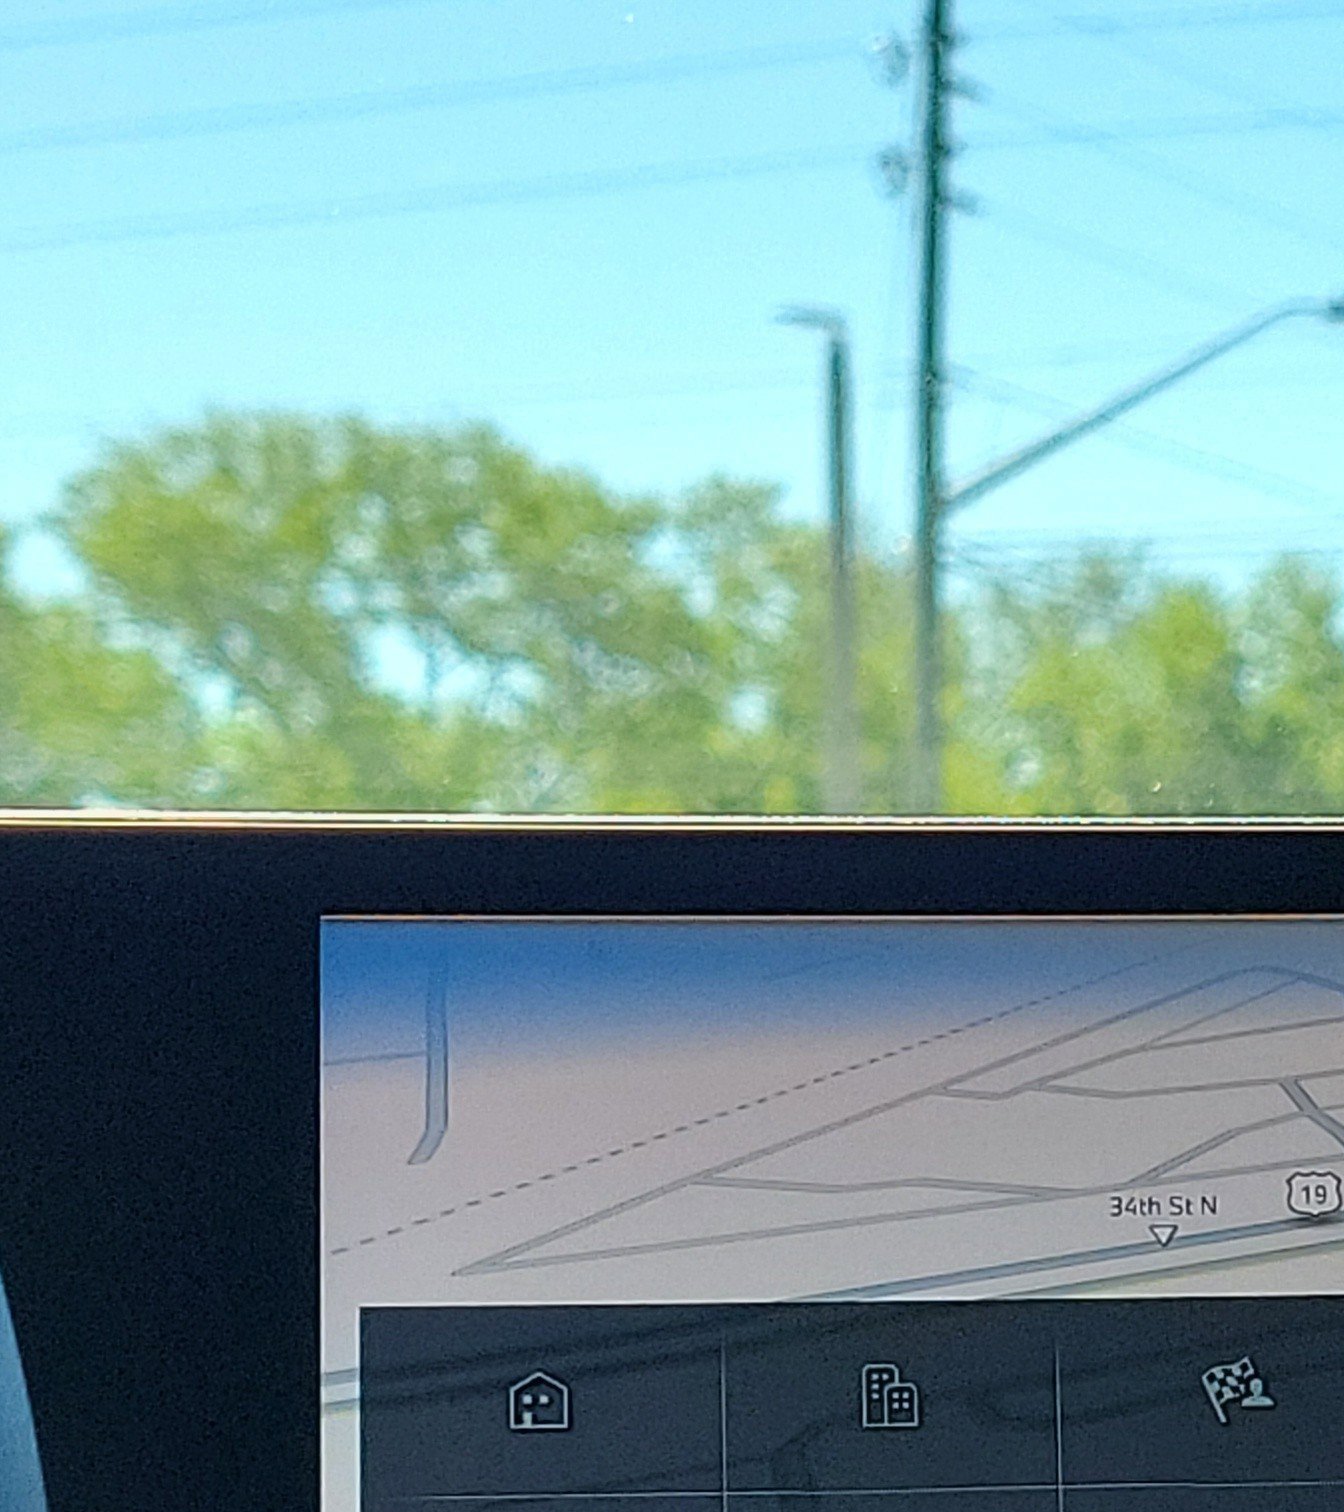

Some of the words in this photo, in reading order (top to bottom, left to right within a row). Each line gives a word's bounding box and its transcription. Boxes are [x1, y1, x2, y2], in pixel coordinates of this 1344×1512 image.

[1302, 1185, 1327, 1205] 19
[1109, 1195, 1162, 1217] 34th
[1168, 1195, 1195, 1216] St
[1201, 1195, 1218, 1215] N
